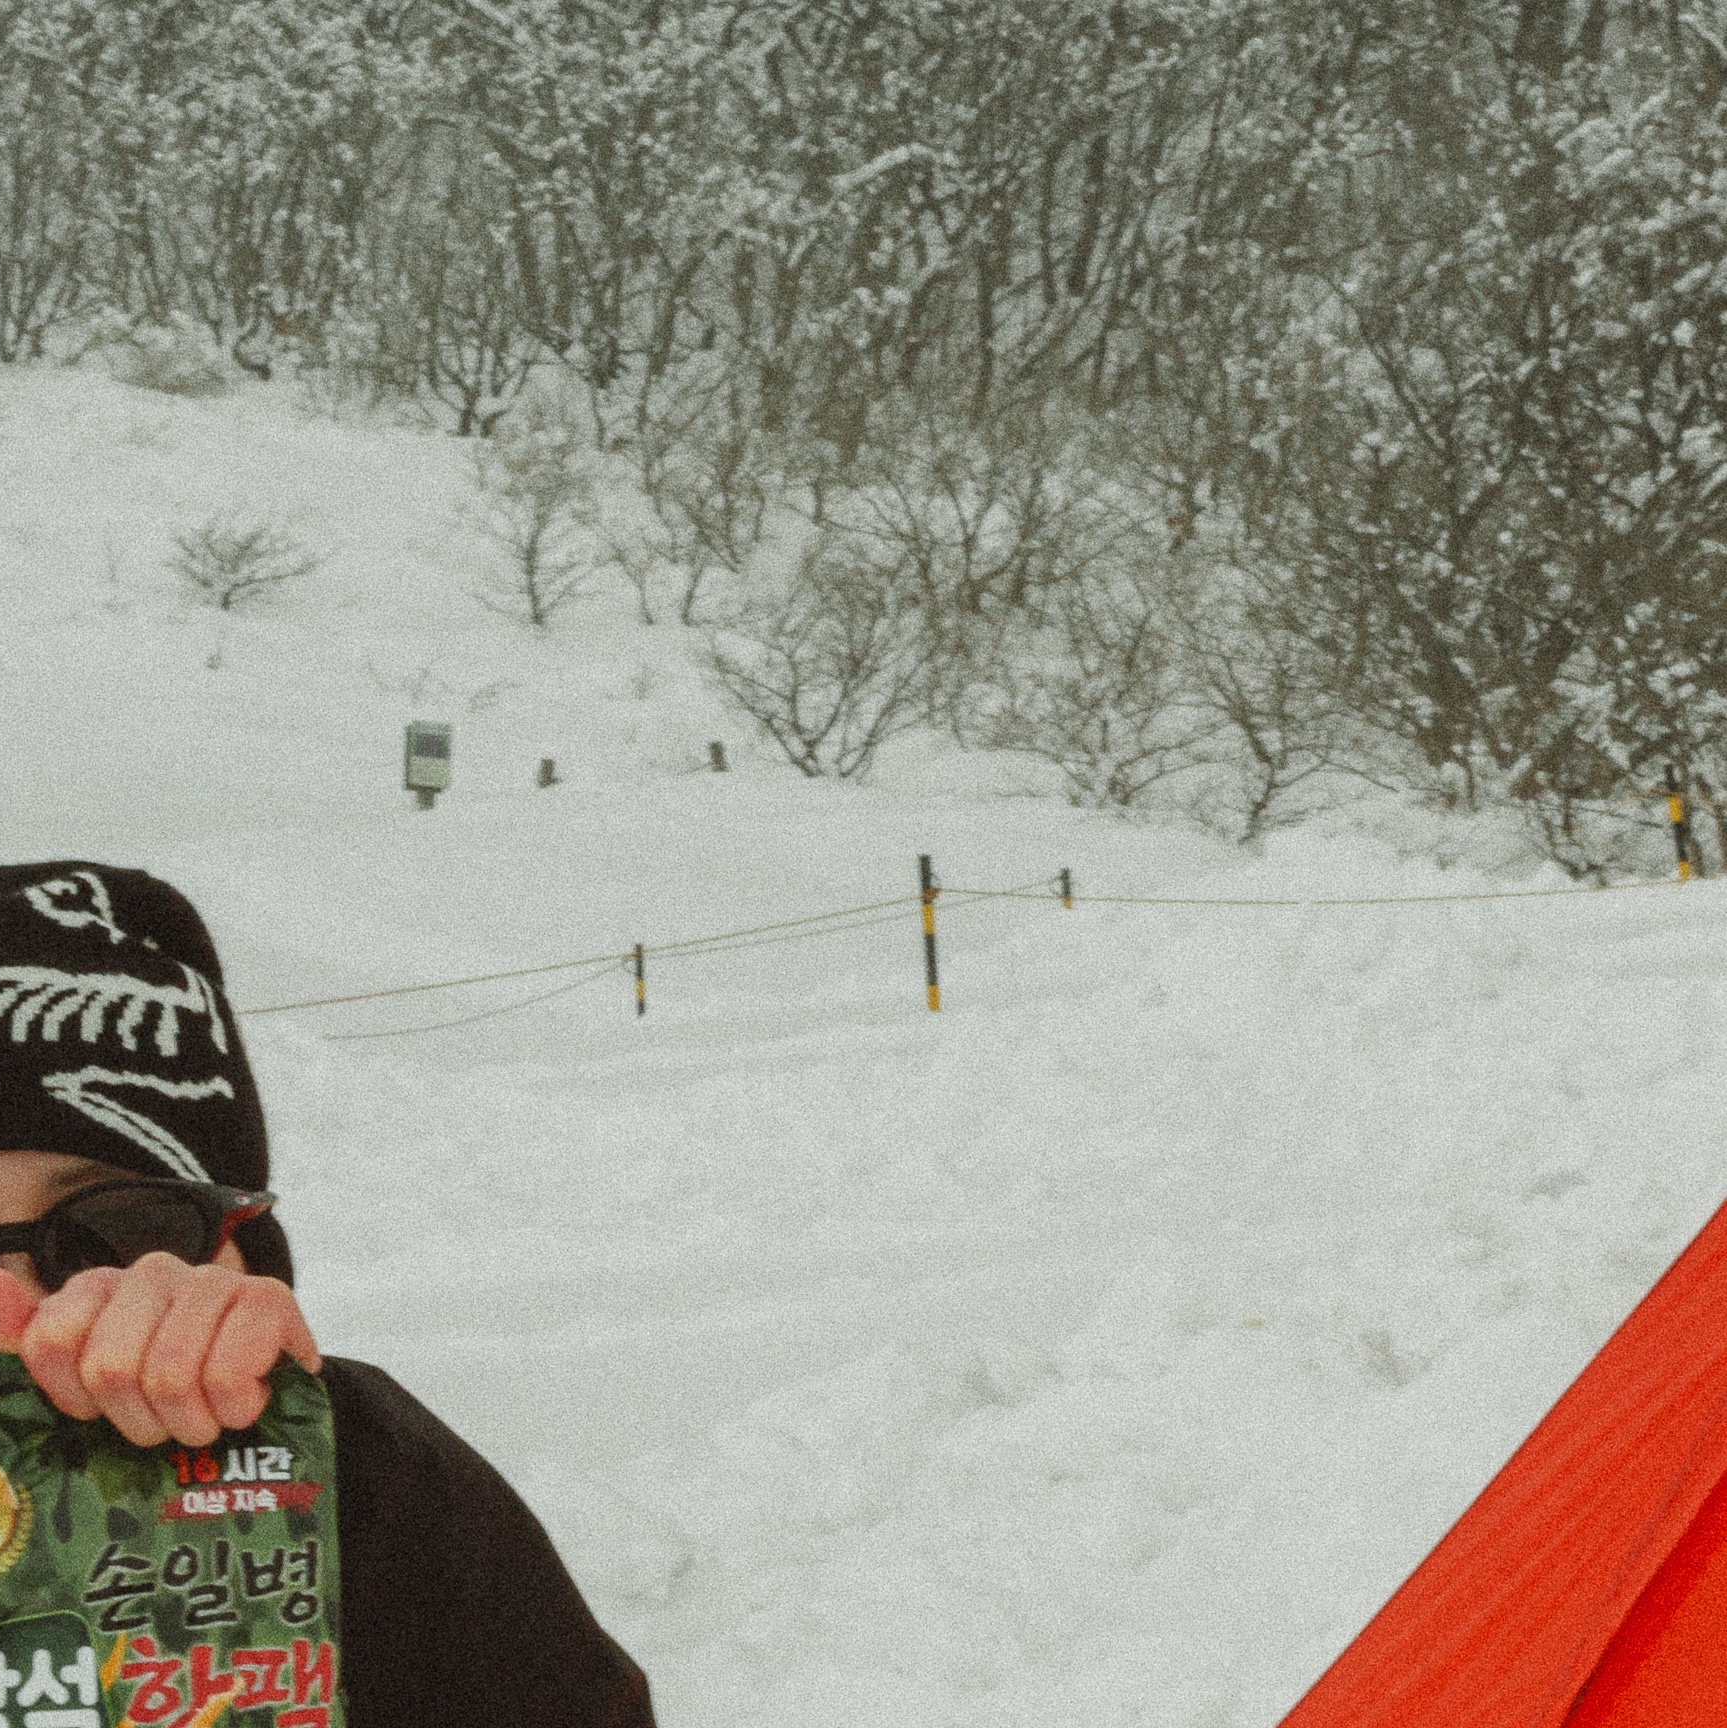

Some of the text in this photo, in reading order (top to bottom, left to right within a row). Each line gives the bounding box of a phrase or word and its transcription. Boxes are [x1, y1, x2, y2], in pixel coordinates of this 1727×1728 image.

[182, 1488, 277, 1514] 이상 지속
[83, 1541, 322, 1634] 손일병
